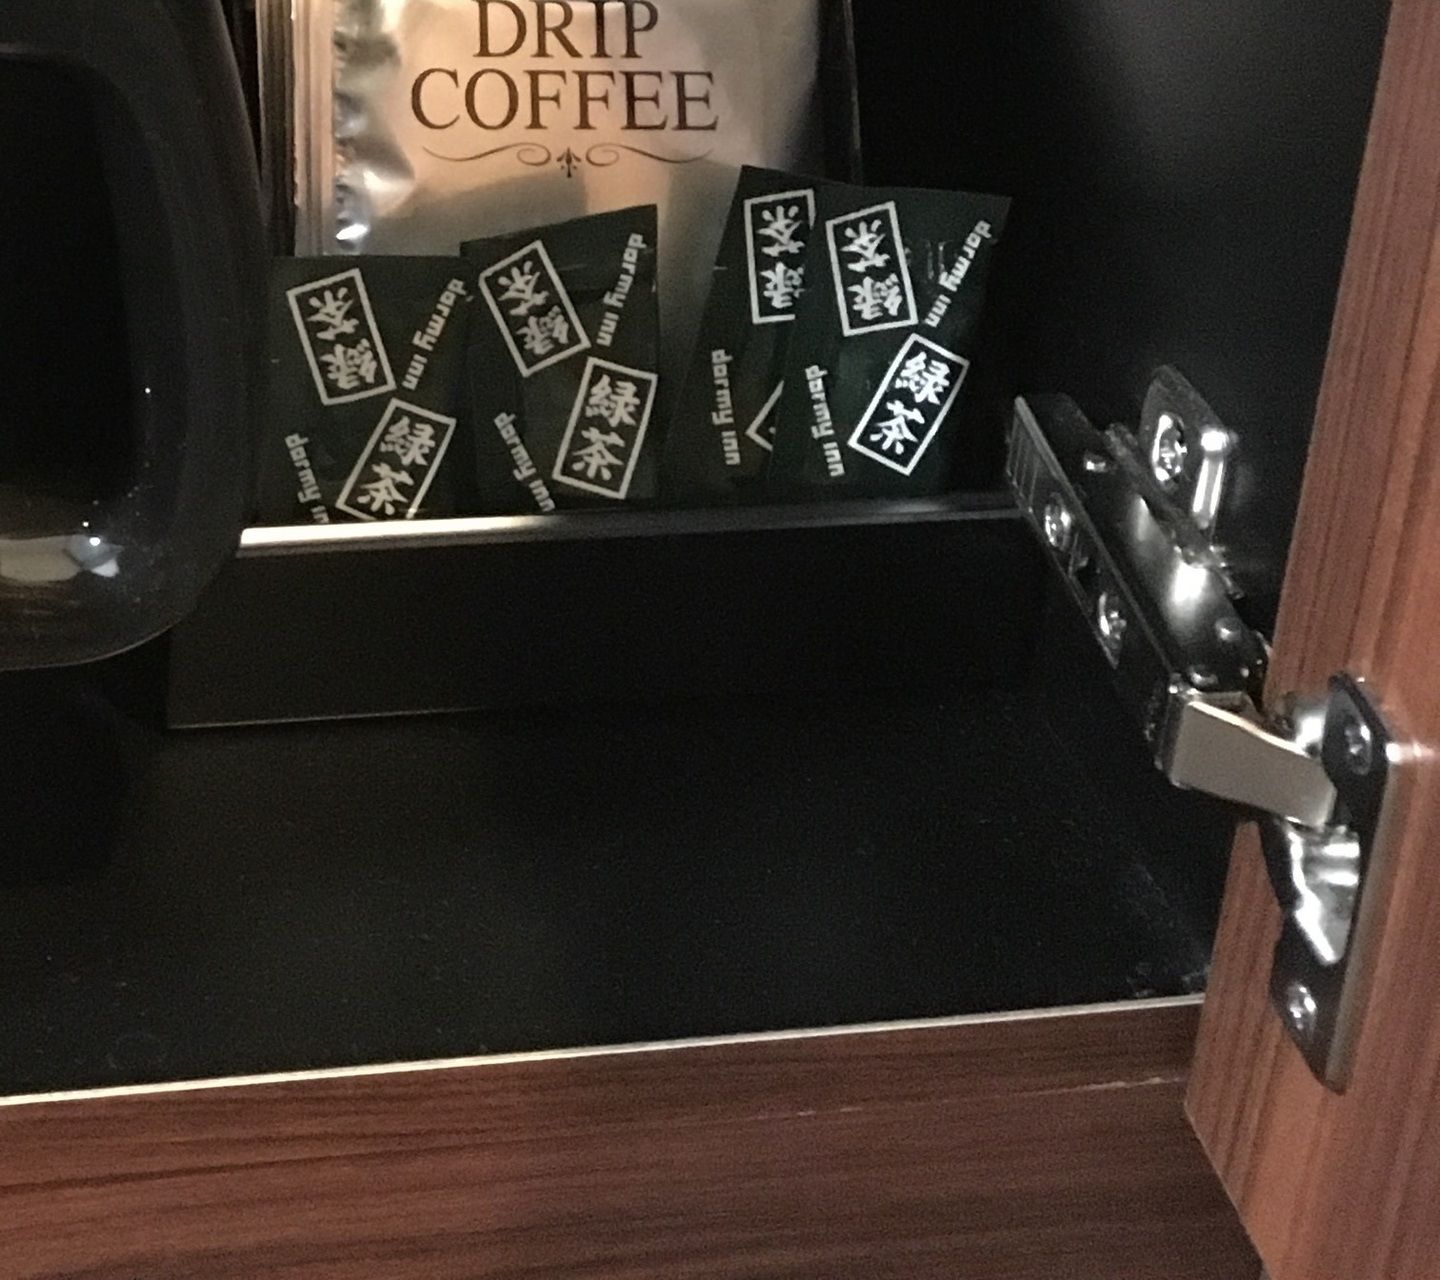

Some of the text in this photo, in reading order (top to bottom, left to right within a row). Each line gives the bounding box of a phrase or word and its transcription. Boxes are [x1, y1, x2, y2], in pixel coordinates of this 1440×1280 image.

[410, 67, 719, 132] COFFEE
[497, 260, 569, 355] 緑茶
[596, 233, 647, 347] dormy inn
[840, 219, 903, 321] 緑茶
[924, 220, 993, 328] dormy inn
[307, 286, 378, 390] 緑茶
[402, 278, 467, 390] dormy inn
[493, 411, 537, 482] dormy
[572, 374, 641, 482] 緑茶
[712, 349, 741, 466] dormy inn
[805, 364, 845, 477] dormy inn
[869, 352, 950, 455] 緑茶
[284, 433, 322, 503] dormy
[357, 415, 436, 515] 緑茶
